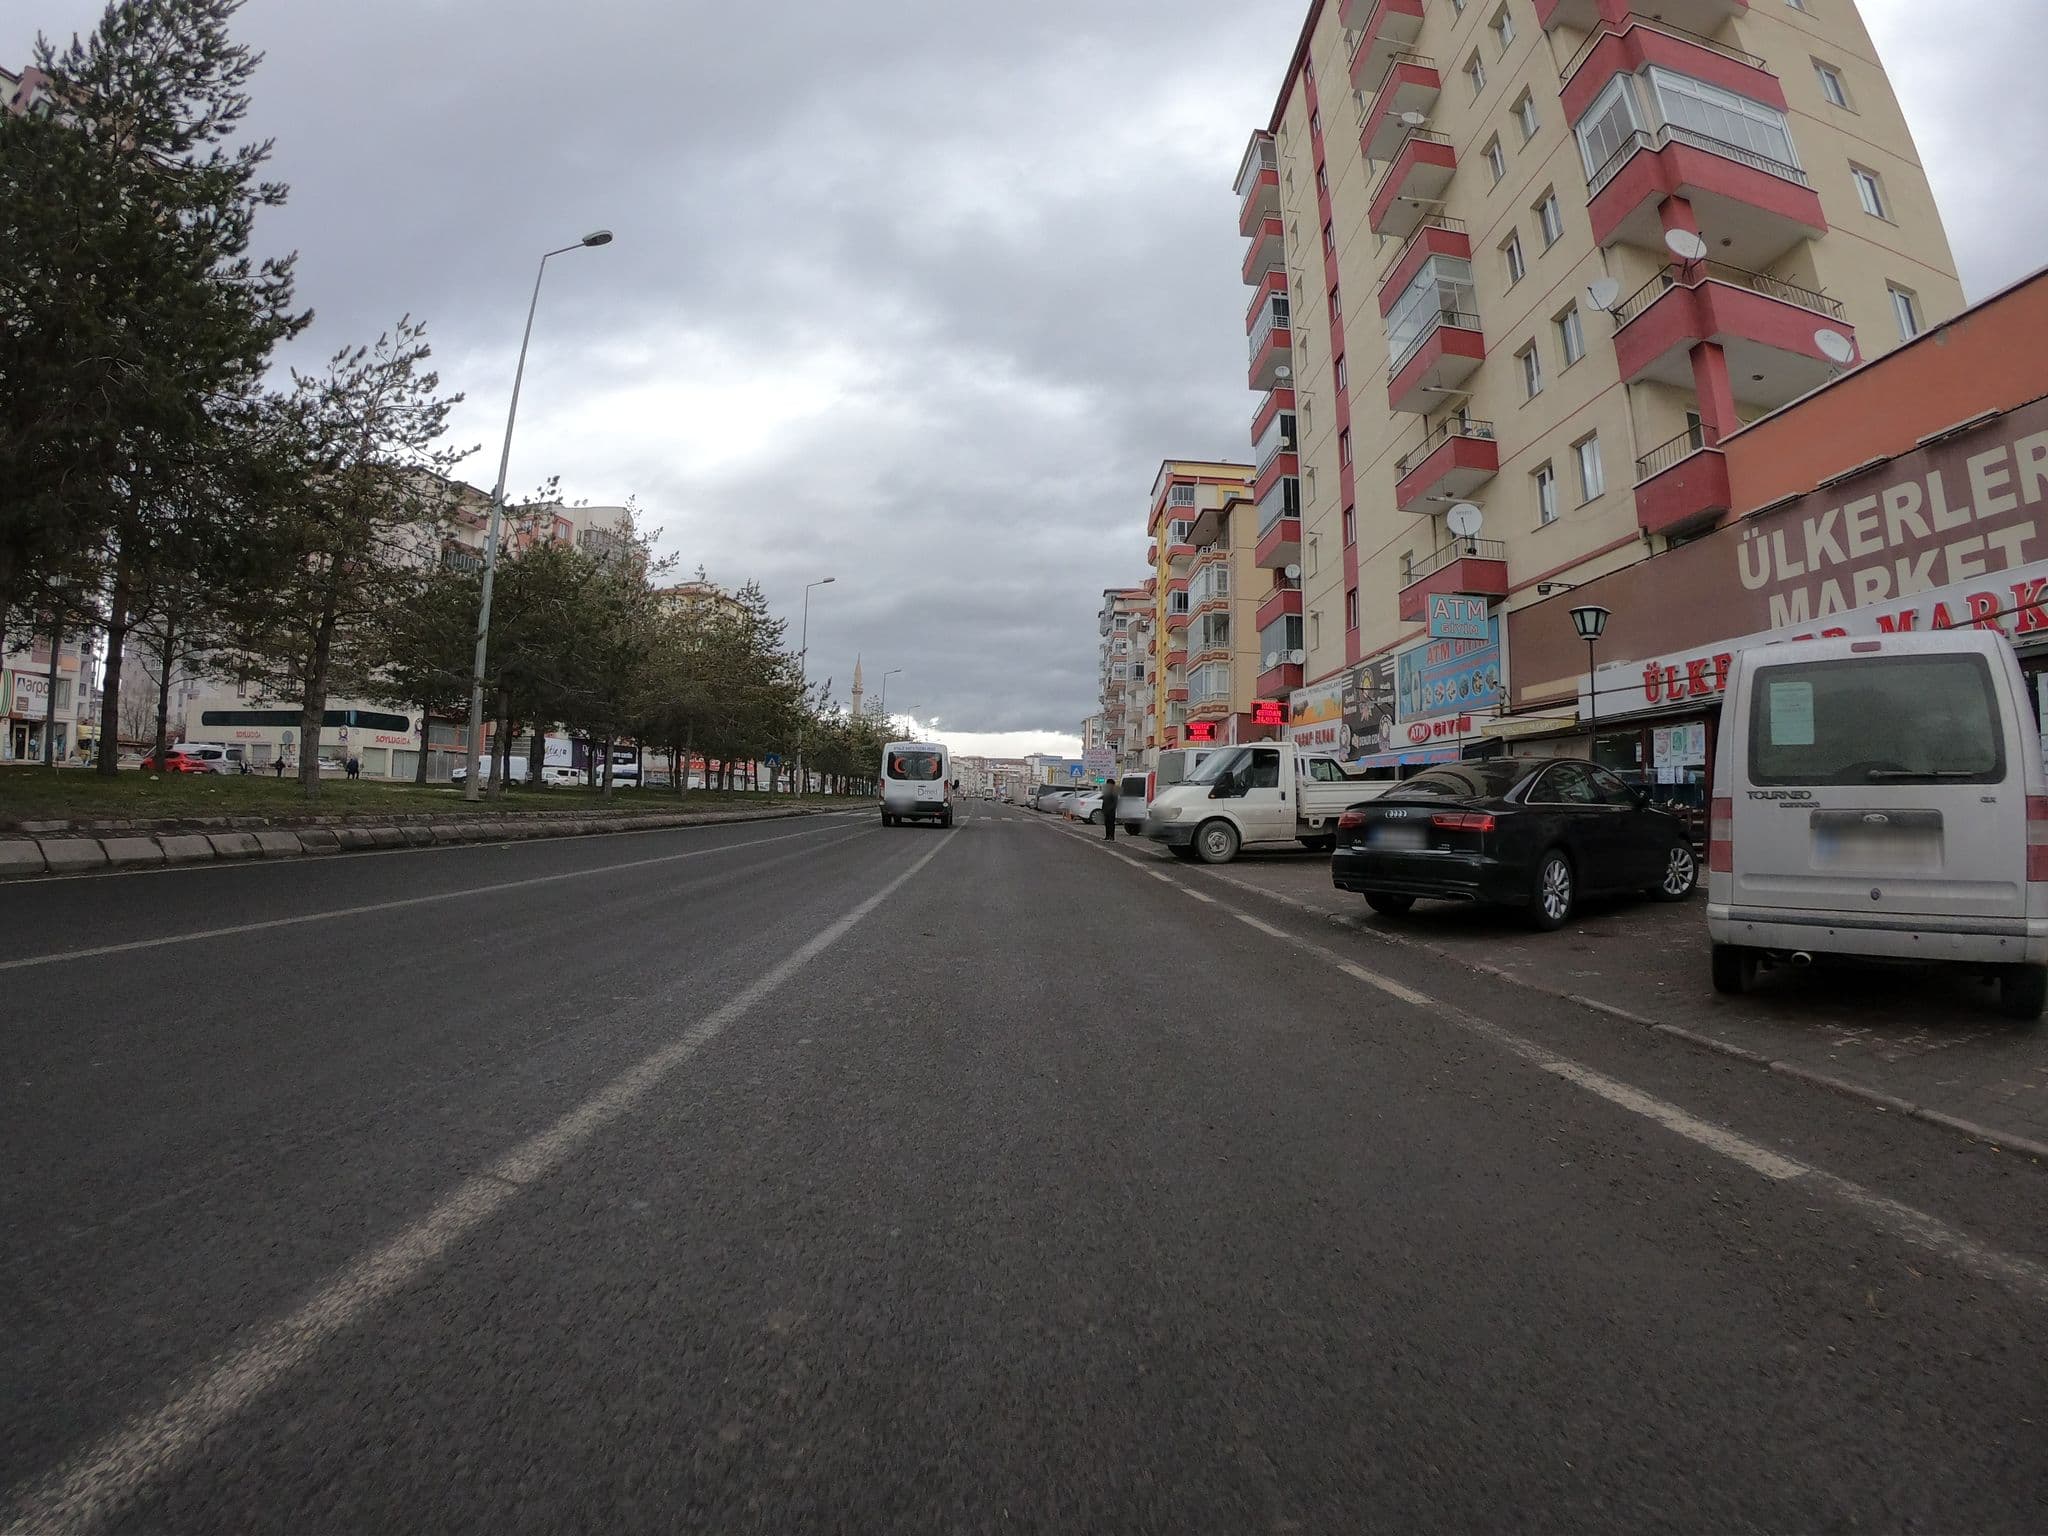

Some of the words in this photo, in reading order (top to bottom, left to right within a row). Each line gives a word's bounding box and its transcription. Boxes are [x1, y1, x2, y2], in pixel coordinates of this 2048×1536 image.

[1736, 430, 2048, 590] ÜLKERLER
[1768, 520, 2037, 631] MARKET
[1434, 599, 1485, 621] ATM
[1427, 641, 1450, 664] ATM
[1747, 790, 1812, 800] TOURNEO
